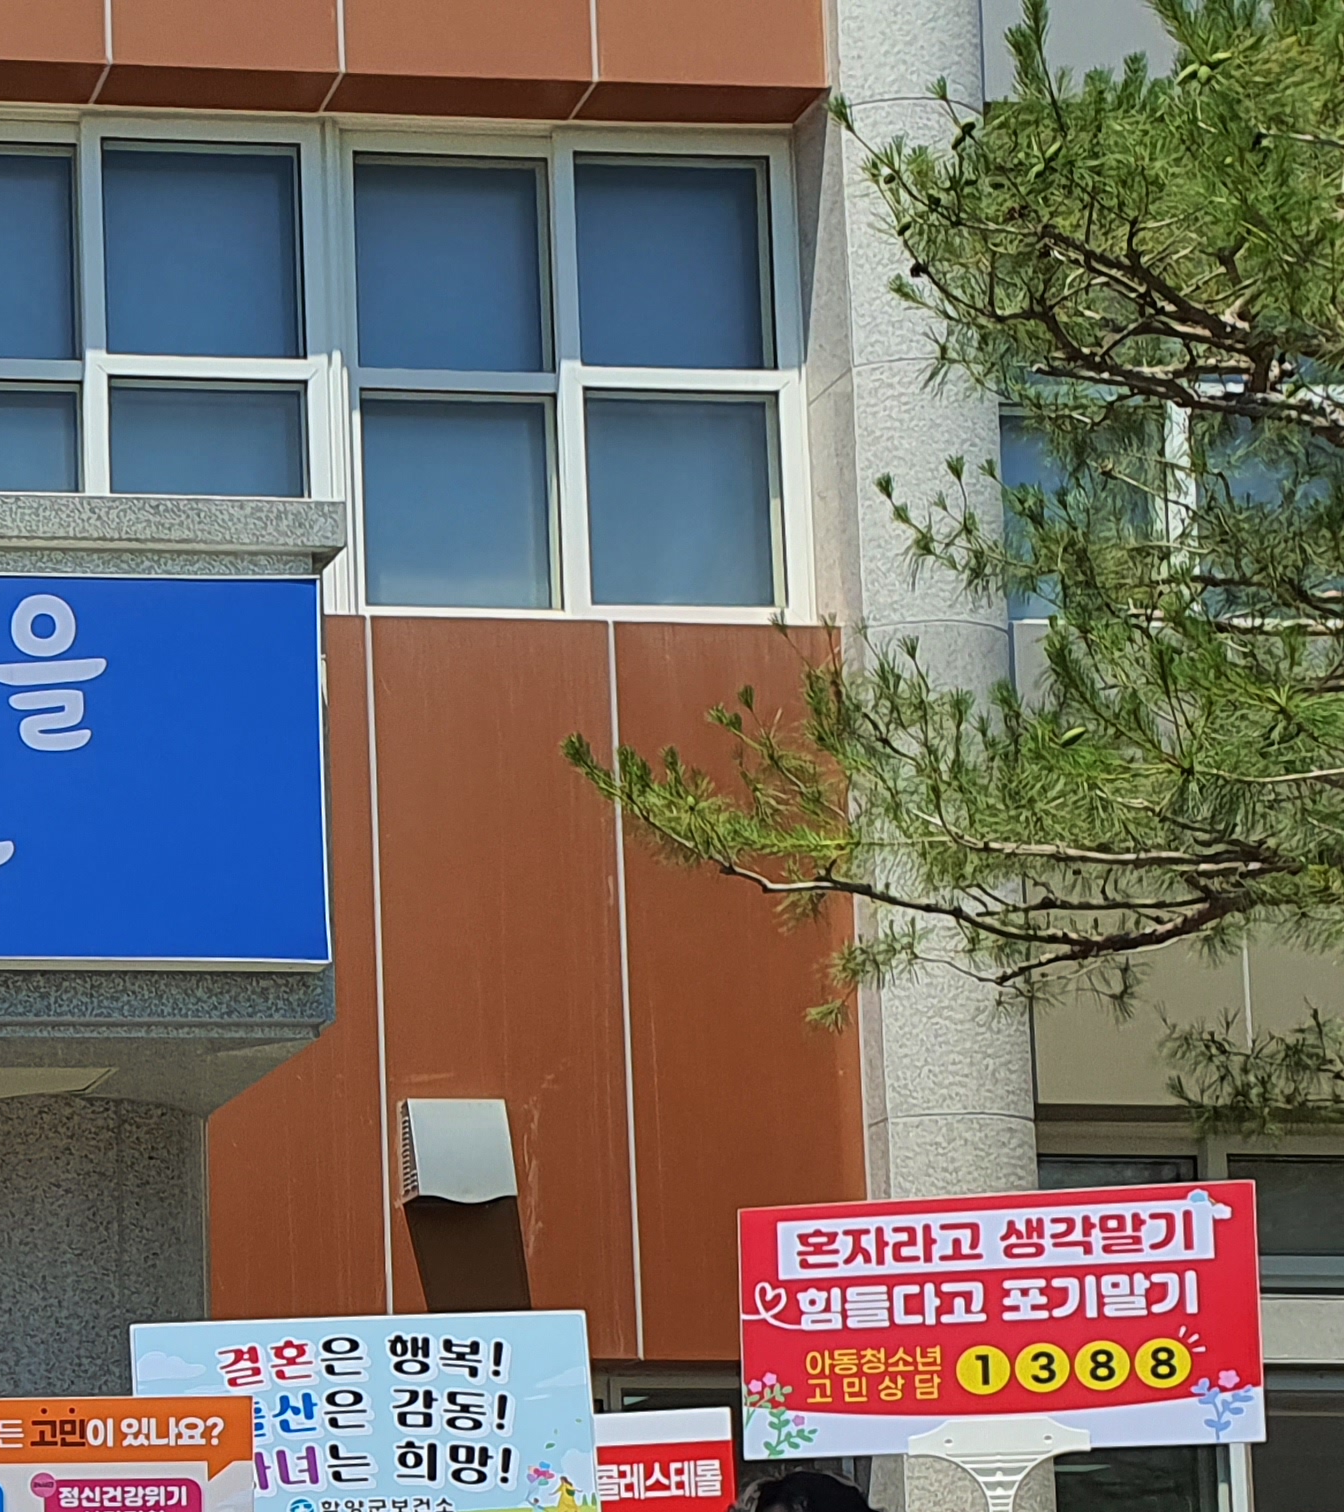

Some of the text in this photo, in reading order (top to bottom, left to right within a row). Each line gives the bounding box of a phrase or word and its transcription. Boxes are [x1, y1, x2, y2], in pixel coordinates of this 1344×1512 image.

[796, 1209, 1194, 1271] 혼자라고 생각말기
[797, 1270, 1200, 1331] 힘들다고 포기말기
[215, 1334, 505, 1390] 결혼은 행복!
[806, 1345, 942, 1376] 아동청소년
[30, 1415, 113, 1448] 고민이
[121, 1415, 225, 1448] 있나요?
[254, 1388, 508, 1438] 산은 감동!
[396, 1439, 513, 1486] 희망!
[597, 1459, 722, 1501] 콜레스테롤
[59, 1486, 187, 1508] 정신건강위기
